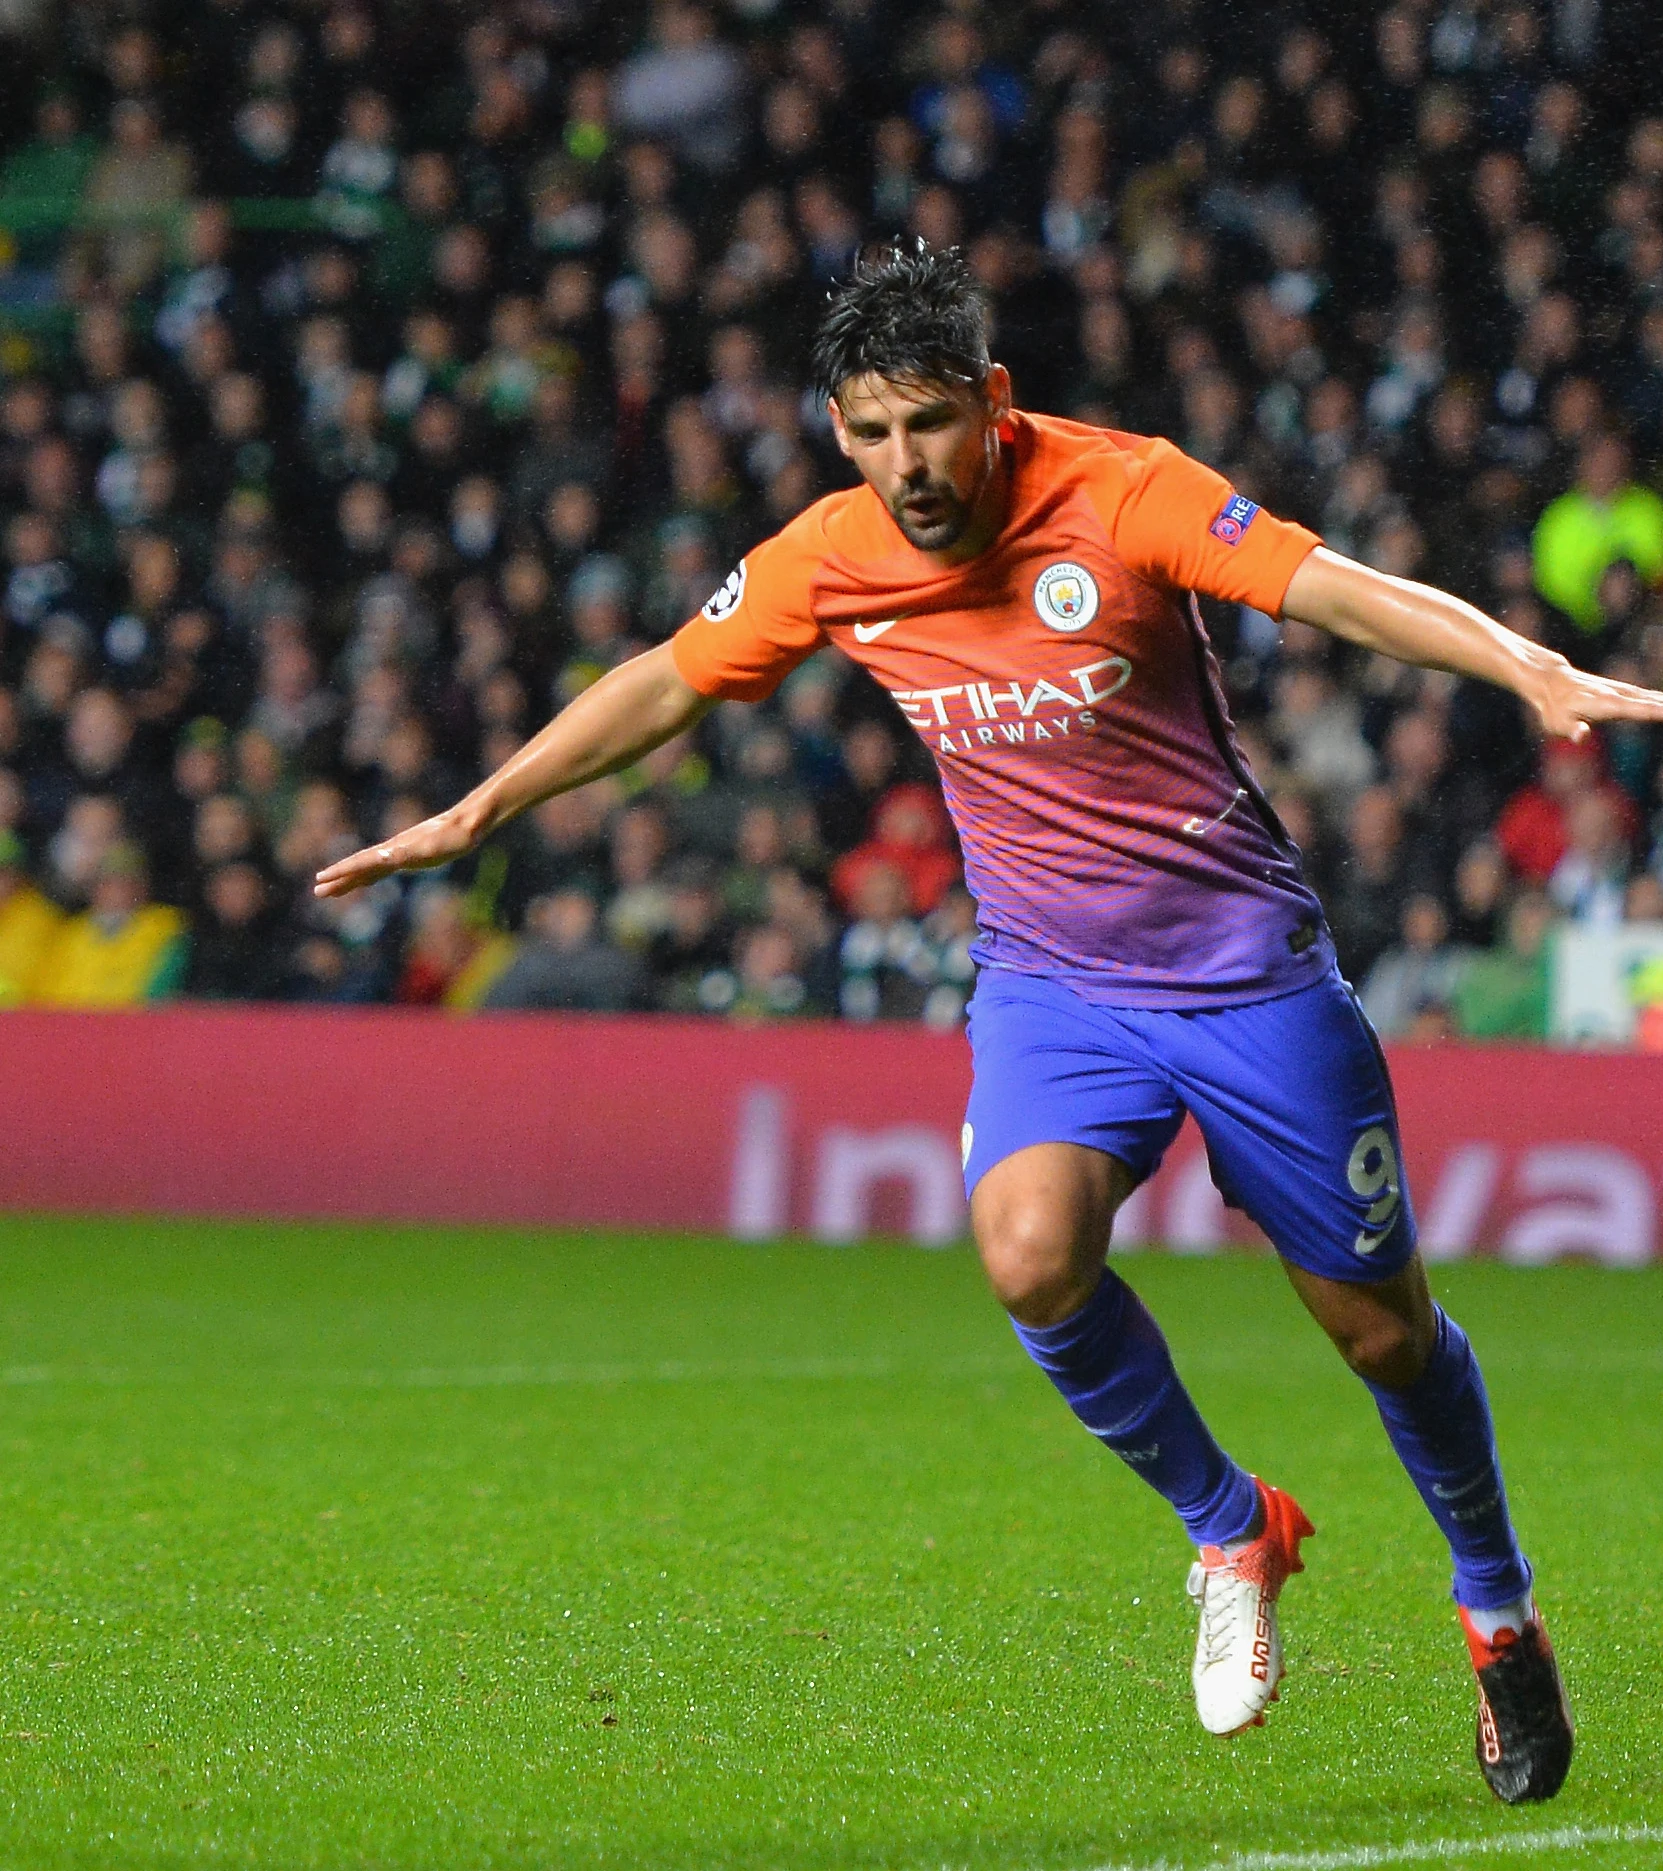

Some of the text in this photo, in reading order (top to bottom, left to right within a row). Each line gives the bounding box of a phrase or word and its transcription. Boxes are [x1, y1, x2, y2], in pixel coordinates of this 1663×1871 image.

[890, 656, 1133, 728] ETIHAD
[938, 710, 1097, 753] AIRWAYS
[1347, 1126, 1400, 1224] 9
